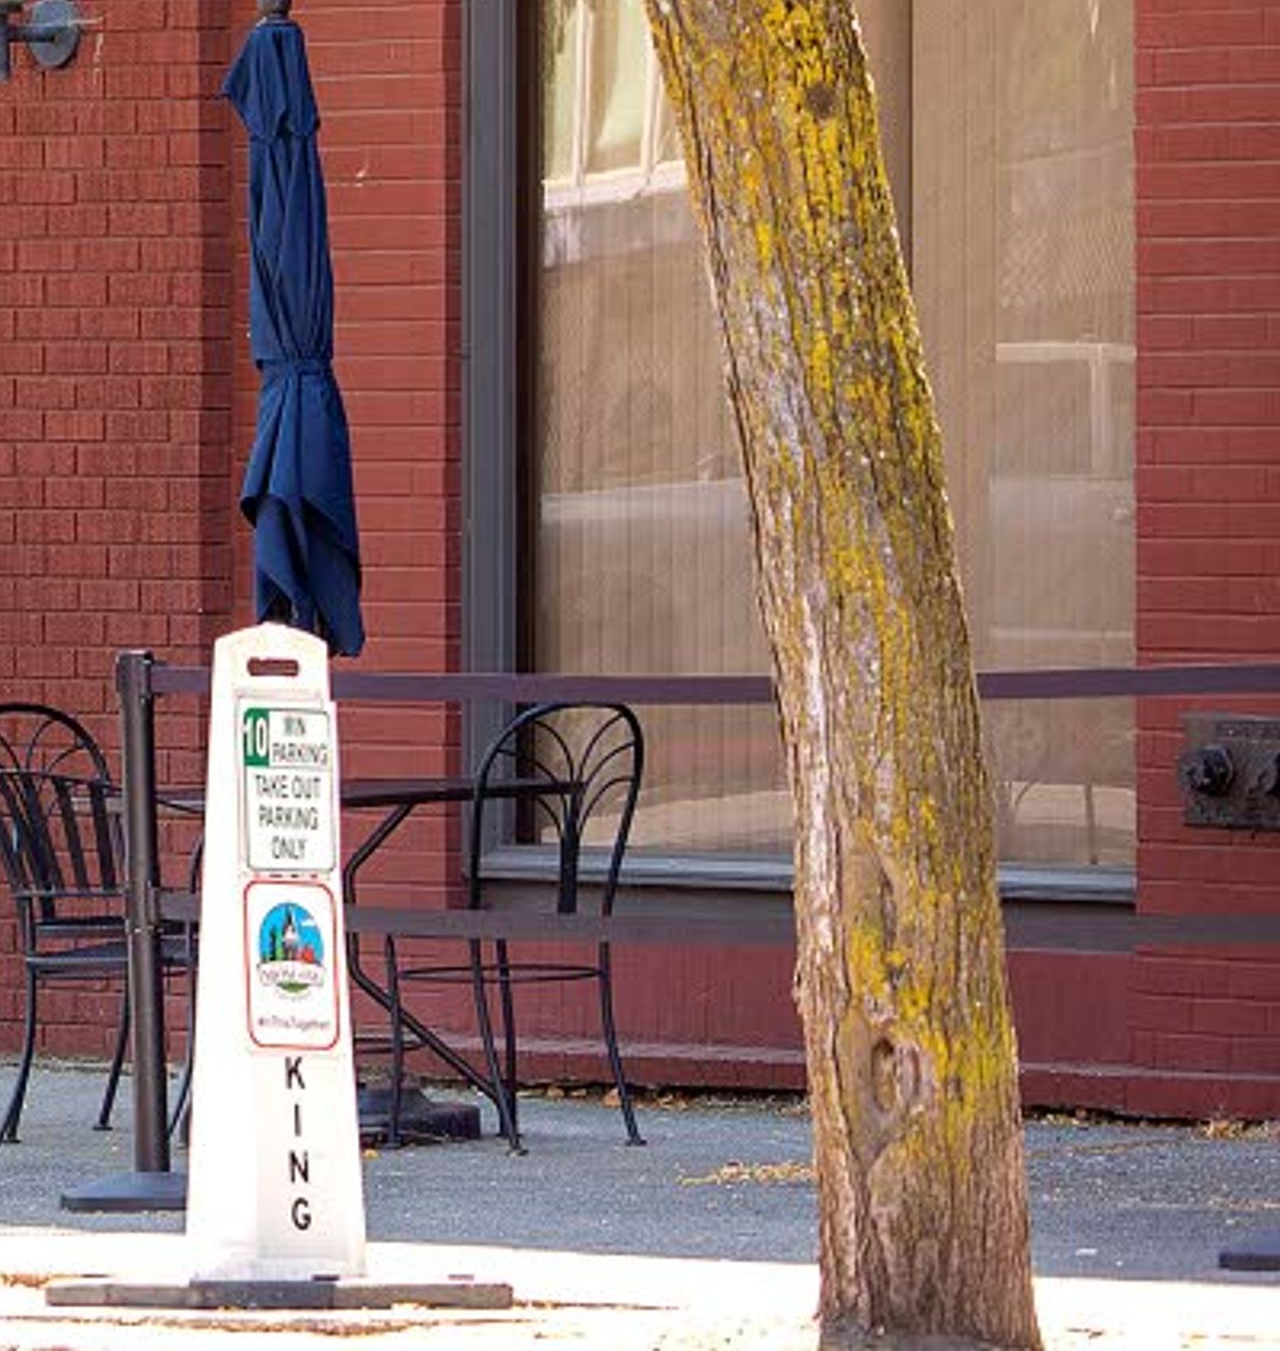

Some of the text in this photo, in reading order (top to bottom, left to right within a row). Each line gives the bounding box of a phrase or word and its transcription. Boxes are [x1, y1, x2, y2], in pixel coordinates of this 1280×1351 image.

[244, 717, 266, 757] 10
[272, 743, 327, 764] PARKING
[256, 775, 320, 798] TAKE OUT
[259, 804, 317, 830] PARKING
[272, 836, 306, 859] ONLY
